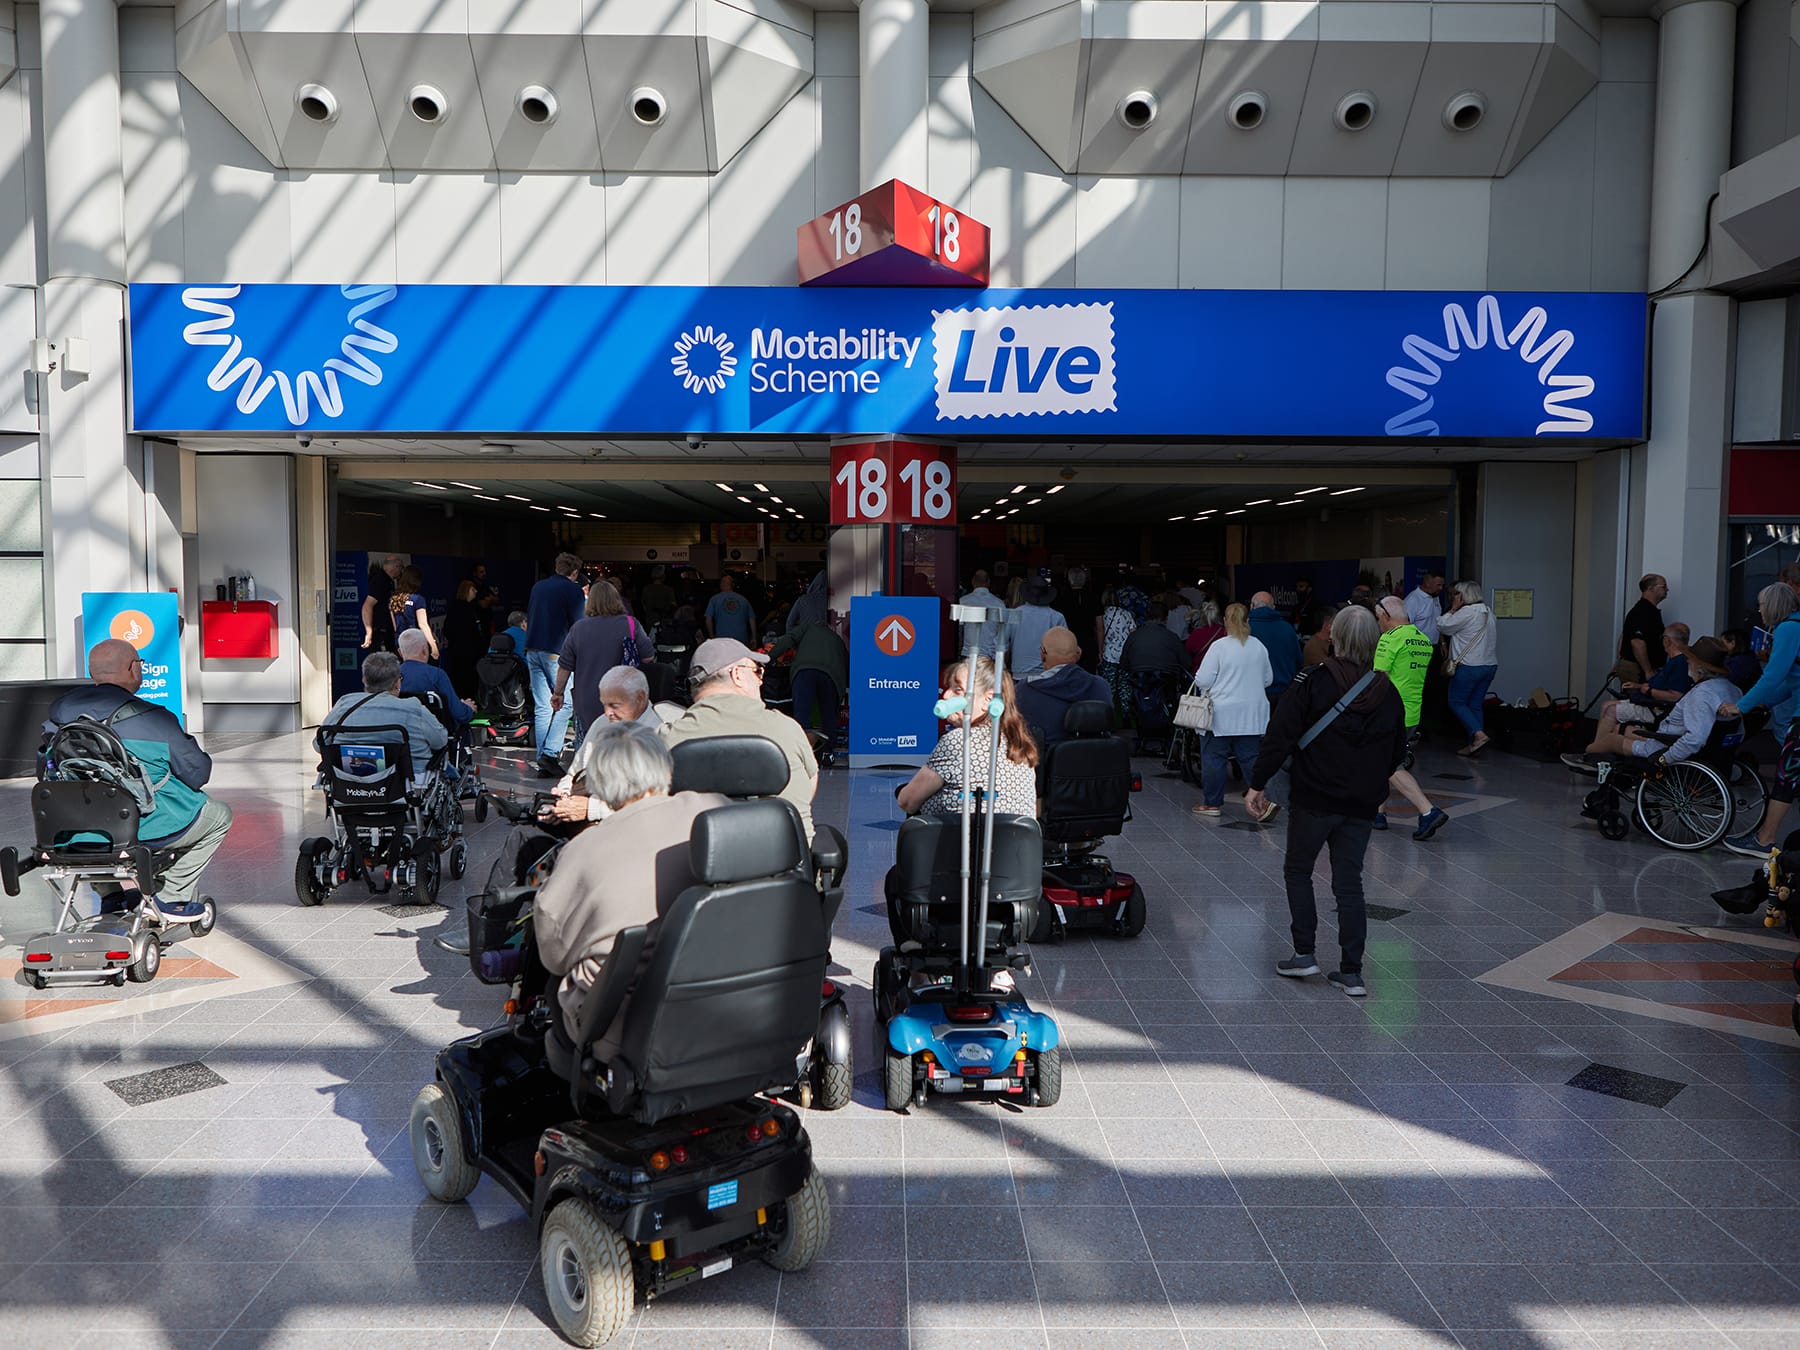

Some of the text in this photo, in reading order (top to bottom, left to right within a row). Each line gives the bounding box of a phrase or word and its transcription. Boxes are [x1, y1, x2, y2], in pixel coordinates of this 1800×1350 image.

[829, 203, 862, 261] 18
[927, 205, 961, 263] 18
[751, 328, 921, 369] Motability
[948, 326, 1102, 396] Live
[751, 363, 881, 394] Scheme
[836, 458, 888, 519] 18
[899, 459, 952, 520] 18
[335, 589, 357, 600] Live
[141, 663, 168, 676] Sign
[869, 677, 920, 690] Entrance
[899, 737, 915, 745] Live
